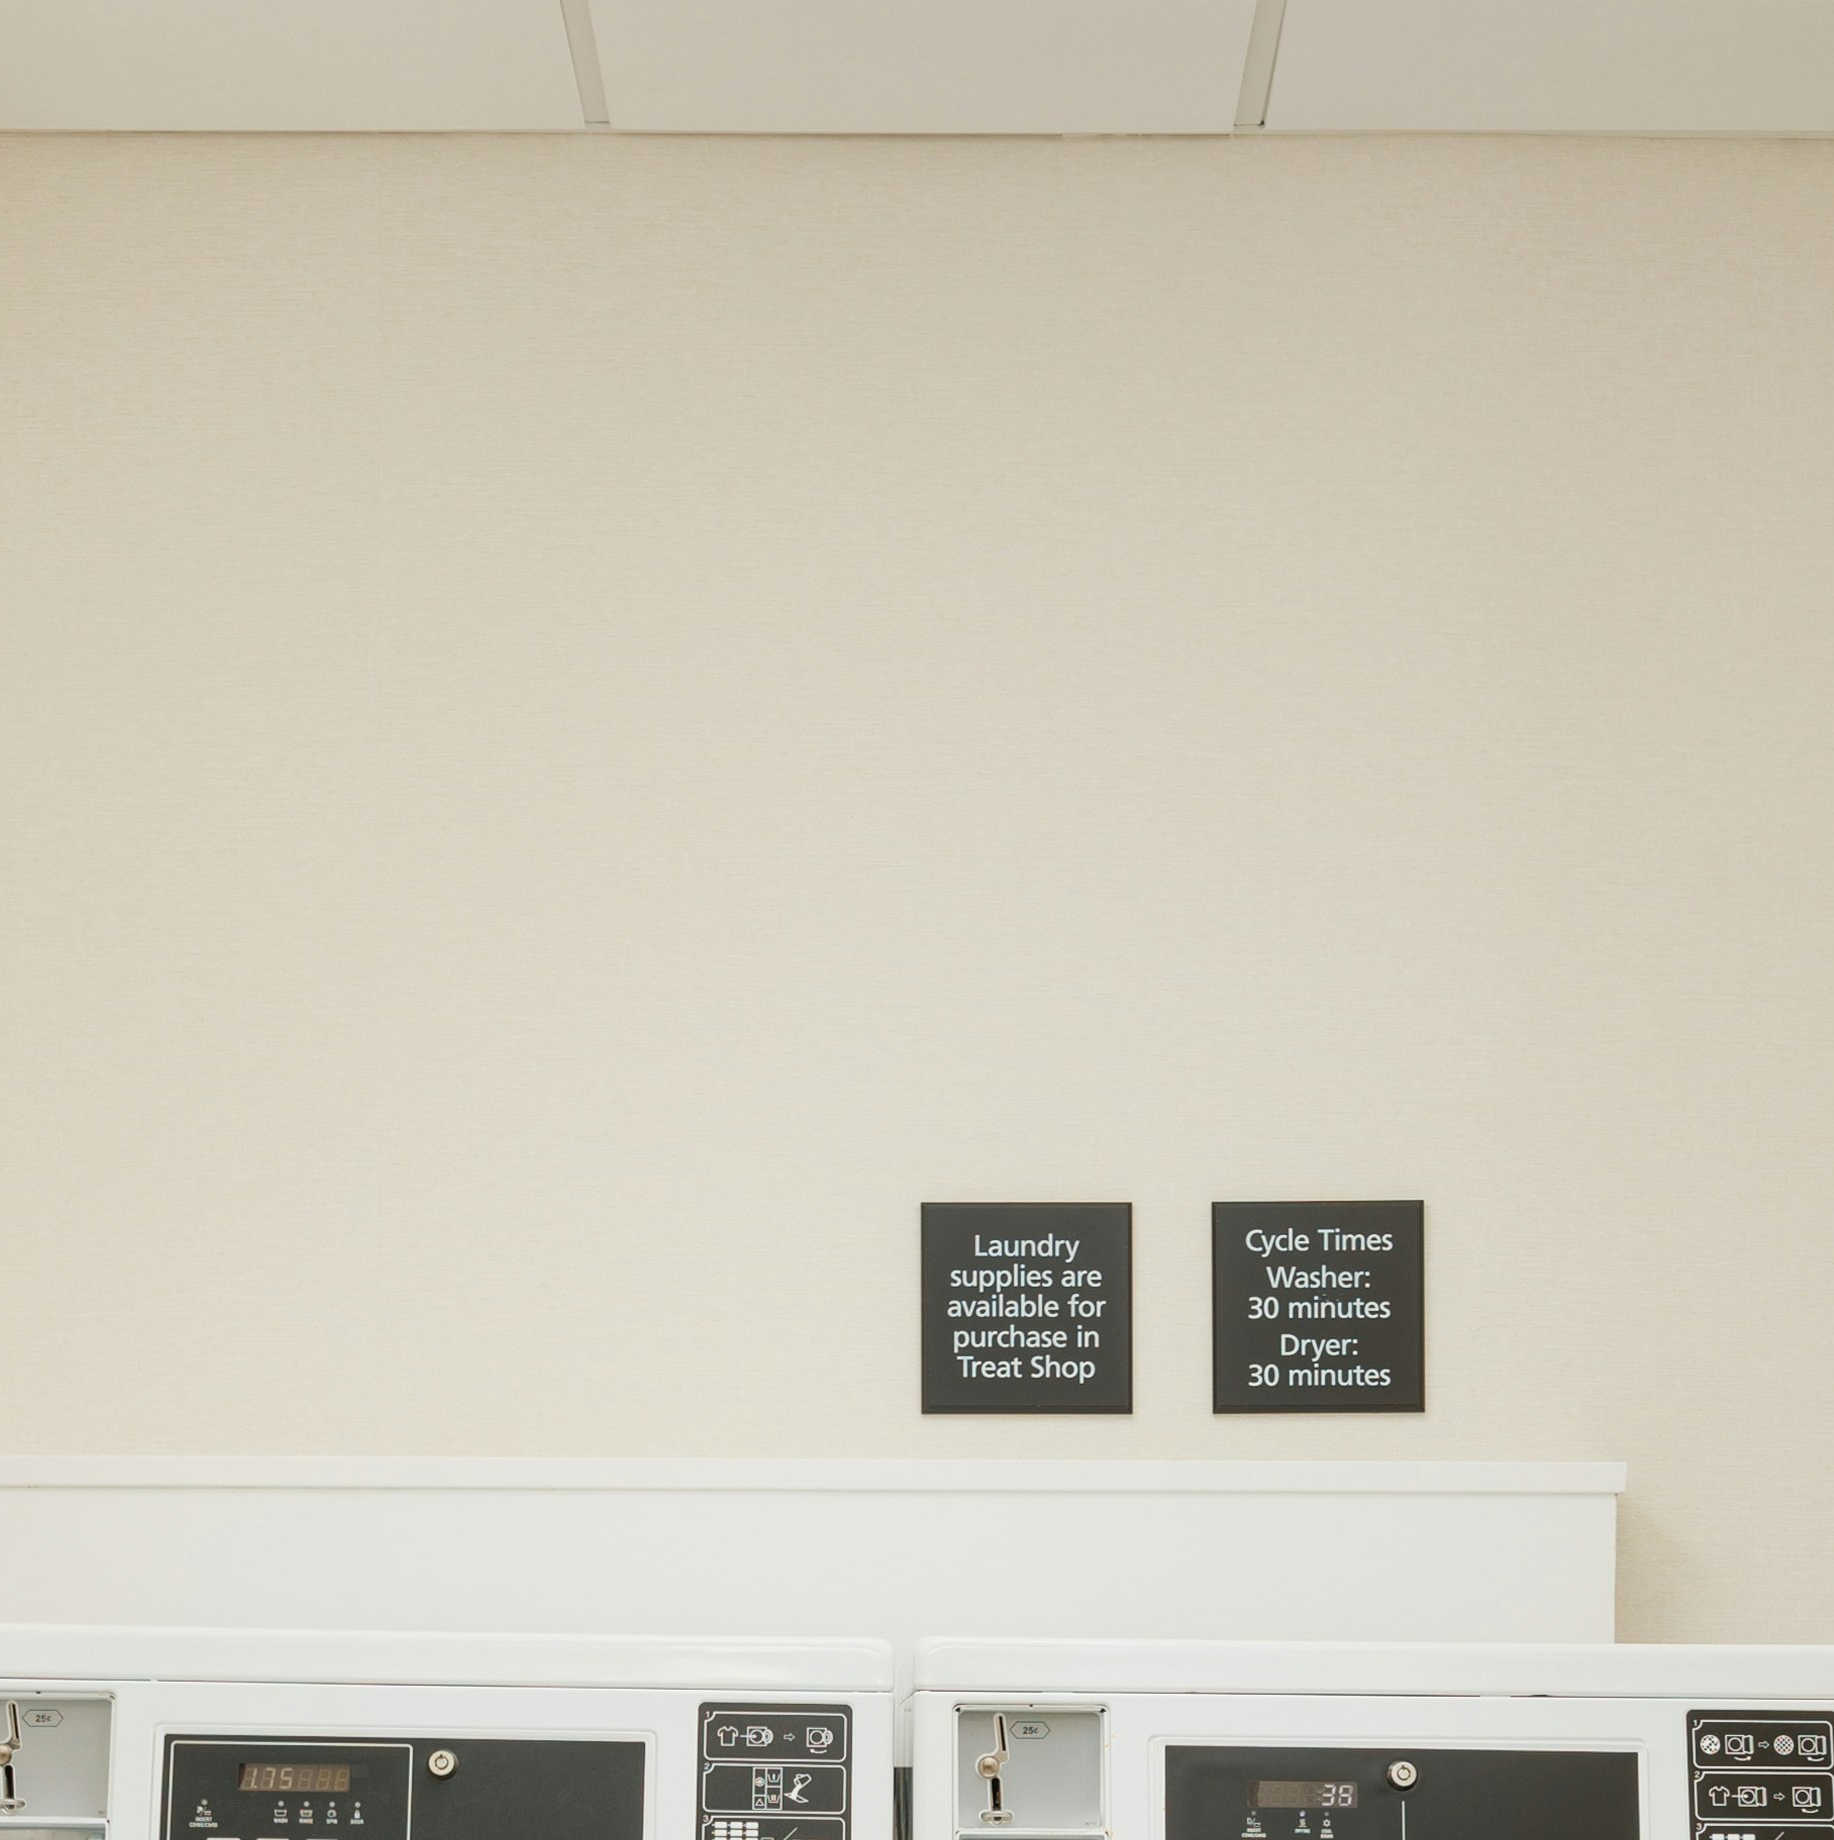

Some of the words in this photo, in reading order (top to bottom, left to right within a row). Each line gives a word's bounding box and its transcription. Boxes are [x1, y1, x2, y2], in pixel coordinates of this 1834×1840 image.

[974, 1232, 1080, 1264] Laundry
[1245, 1227, 1310, 1258] Cycle
[1317, 1227, 1394, 1252] Times
[950, 1262, 1053, 1293] supplies
[1060, 1269, 1103, 1288] are
[1265, 1264, 1371, 1289] Washer:
[946, 1293, 1060, 1318] available
[1066, 1293, 1107, 1318] for
[1247, 1296, 1280, 1320] 30
[1288, 1295, 1391, 1319] minutes
[953, 1323, 1068, 1354] purchase
[1076, 1324, 1100, 1348] in
[1280, 1333, 1358, 1363] Dryer:
[956, 1355, 1023, 1379] Treat
[1030, 1354, 1096, 1385] Shop
[1247, 1363, 1280, 1387] 30
[1288, 1362, 1391, 1387] minutes
[704, 1762, 710, 1770] 2
[1694, 1770, 1701, 1778] 2
[702, 1814, 709, 1823] 3
[1696, 1822, 1702, 1831] 3
